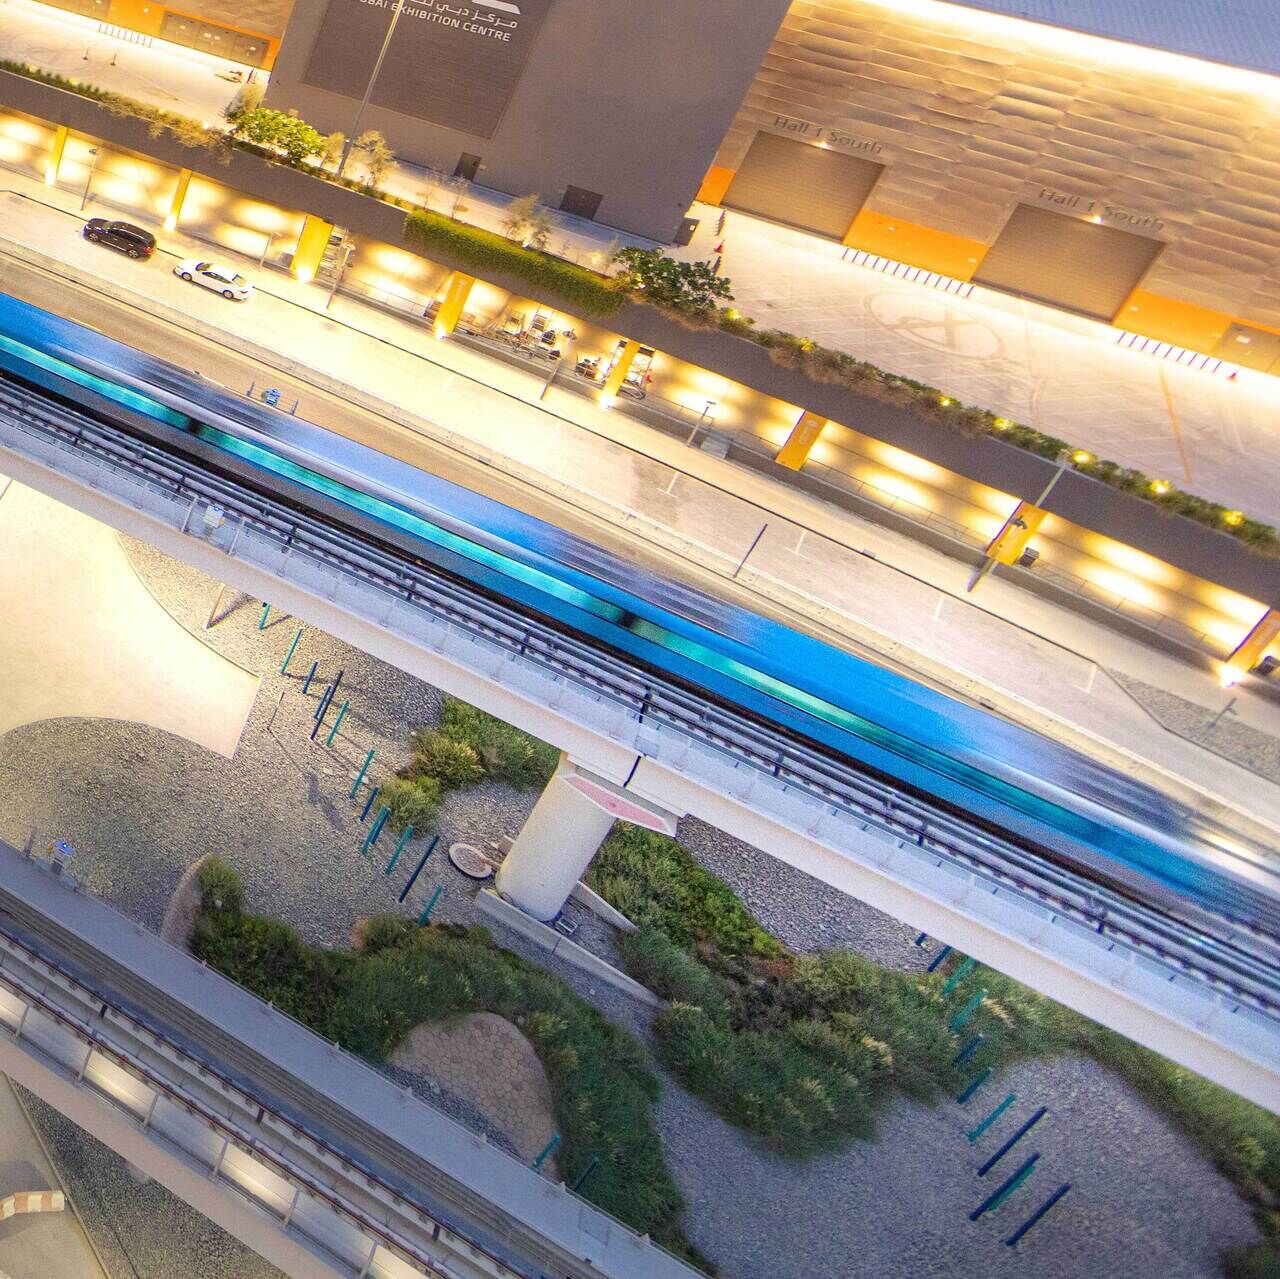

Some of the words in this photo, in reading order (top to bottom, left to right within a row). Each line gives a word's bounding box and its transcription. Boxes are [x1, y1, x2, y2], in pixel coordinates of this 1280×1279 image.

[391, 3, 461, 29] EXHIBITION
[462, 22, 512, 42] CENTRE
[436, 3, 469, 16] دبي
[471, 9, 518, 29] مركز
[773, 116, 810, 134] Hall
[827, 130, 883, 155] South
[1039, 188, 1080, 208] Hall
[1103, 205, 1165, 231] South
